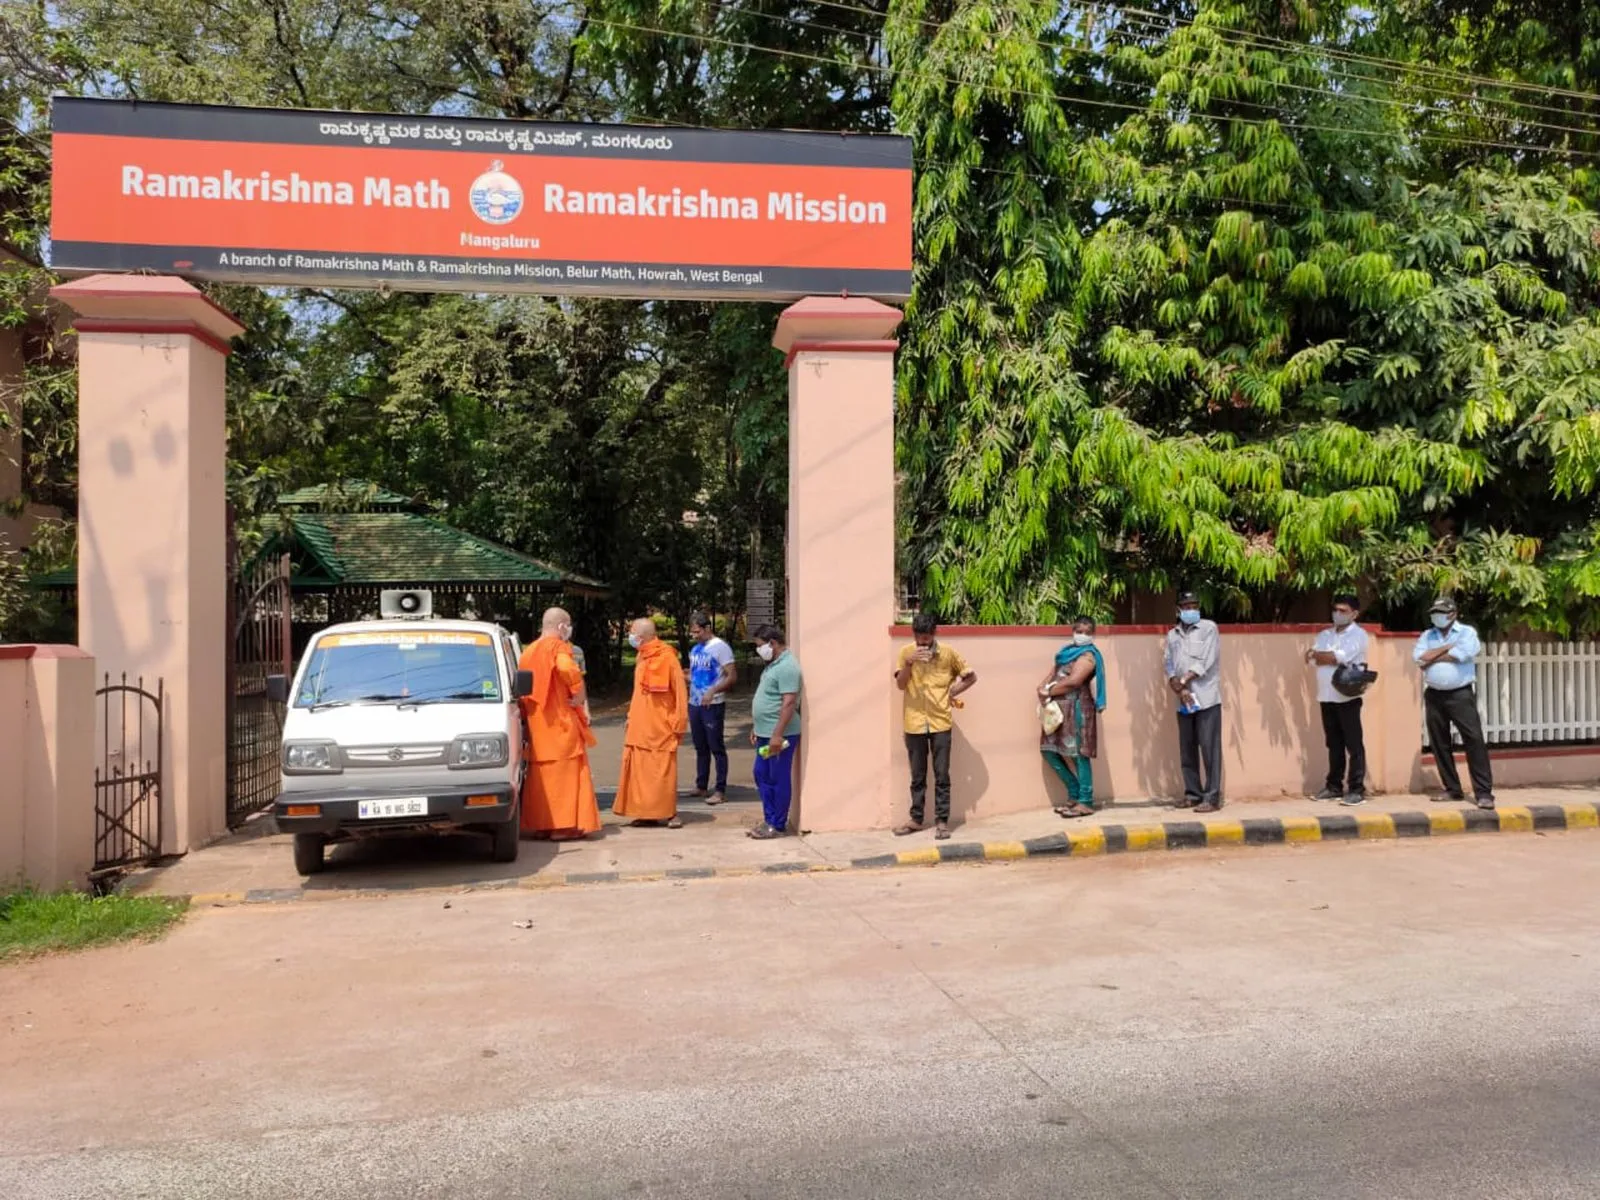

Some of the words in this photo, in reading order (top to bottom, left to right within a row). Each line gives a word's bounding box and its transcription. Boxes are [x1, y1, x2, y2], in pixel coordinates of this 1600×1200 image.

[423, 125, 462, 146] ಮತ್ತು
[591, 132, 673, 150] ಮಂಗಳೂರು
[123, 165, 353, 205] Ramakrishna
[364, 177, 449, 208] Math
[545, 184, 758, 219] Ramakrishna
[768, 192, 886, 223] Mission
[460, 232, 540, 250] Mangaluru
[220, 253, 228, 264] A
[231, 253, 275, 266] branch
[278, 255, 292, 267] of
[295, 255, 379, 270] Ramakrishna
[382, 259, 414, 272] Math
[416, 260, 427, 272] &
[430, 260, 511, 276] Ramakrishna
[514, 264, 564, 279] Mission,
[567, 265, 599, 278] Belur
[601, 267, 635, 280] Math,
[638, 268, 687, 282] Howrah,
[690, 270, 720, 282] West
[723, 270, 763, 285] Bengal
